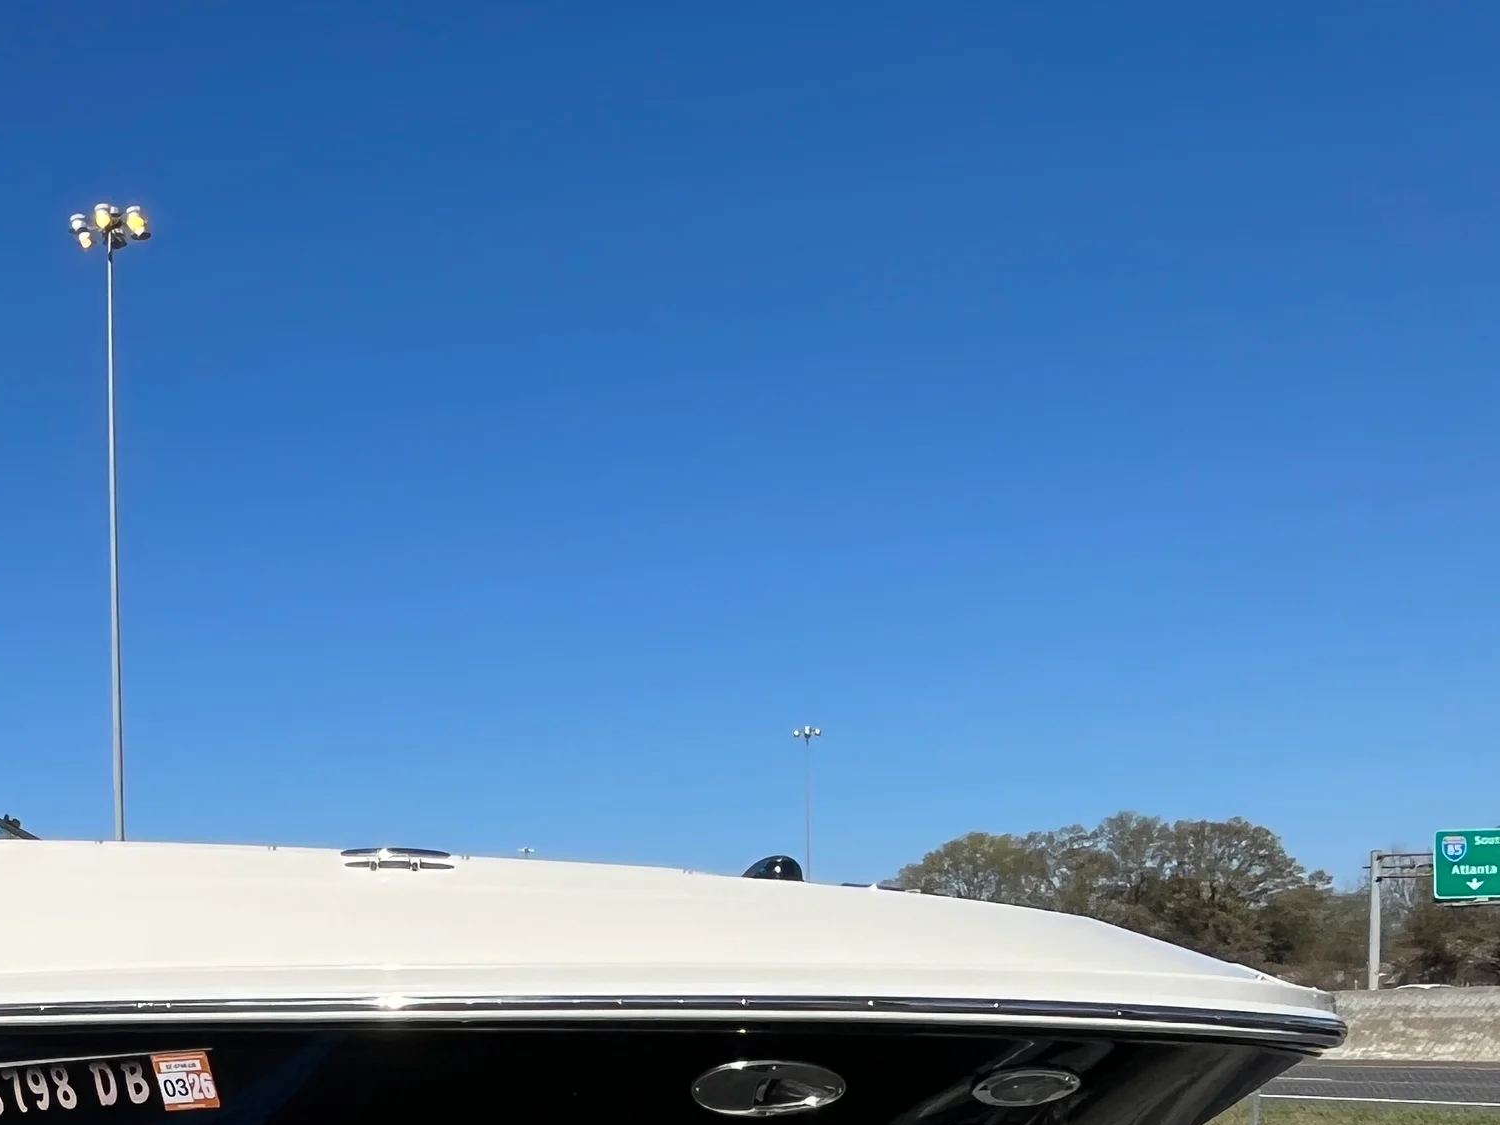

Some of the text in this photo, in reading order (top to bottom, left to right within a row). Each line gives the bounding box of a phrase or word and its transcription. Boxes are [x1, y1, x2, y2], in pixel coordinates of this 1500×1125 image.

[1447, 844, 1463, 856] 85
[1451, 864, 1498, 875] Atlanta
[88, 1061, 150, 1107] DB
[163, 1072, 216, 1100] 03 26
